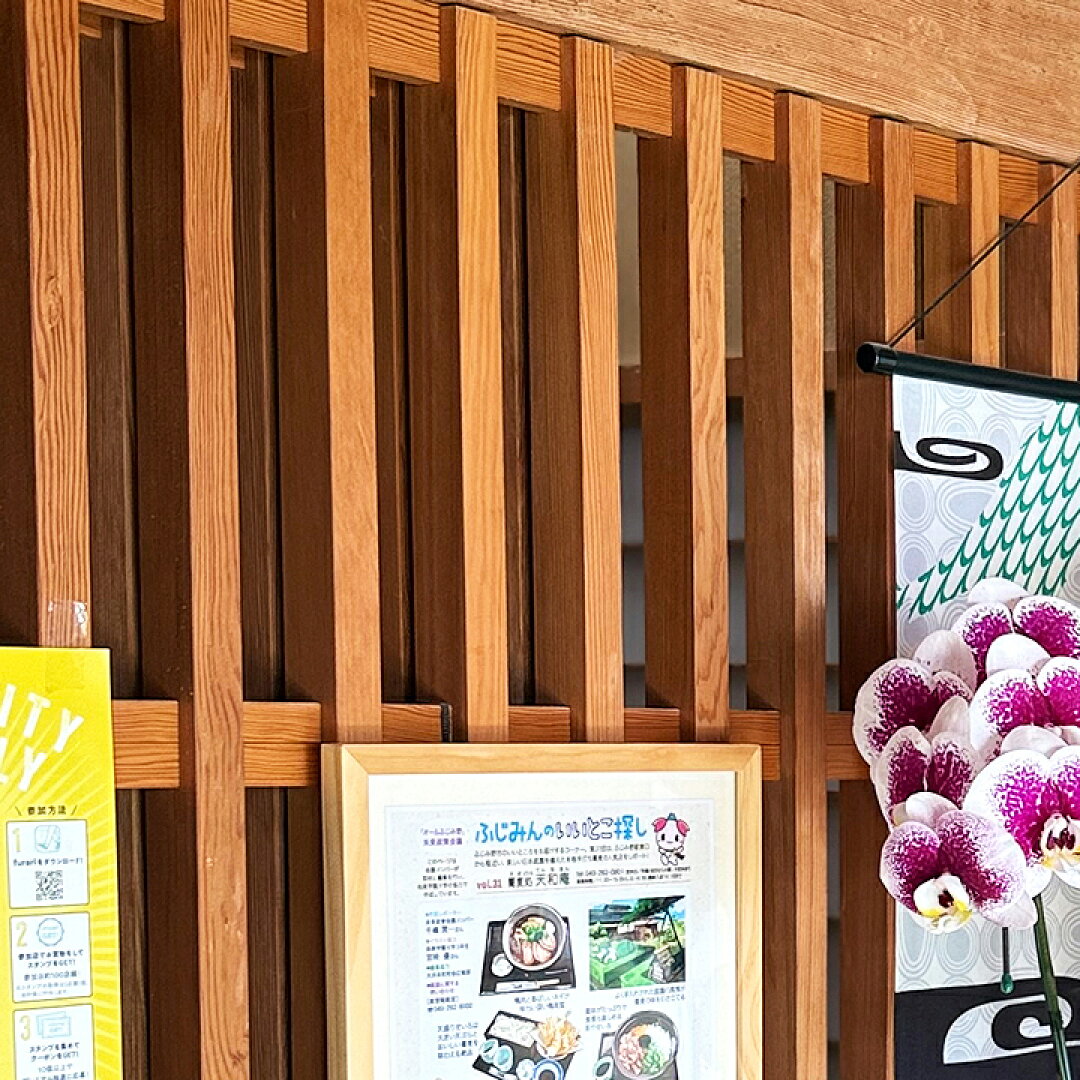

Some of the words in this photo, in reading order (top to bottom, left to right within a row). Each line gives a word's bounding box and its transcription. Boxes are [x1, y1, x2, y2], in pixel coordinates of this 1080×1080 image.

[13, 828, 21, 852] 1
[474, 815, 648, 844] ふじみんのいいとこ探し
[16, 921, 28, 947] 2
[19, 1015, 31, 1041] 3
